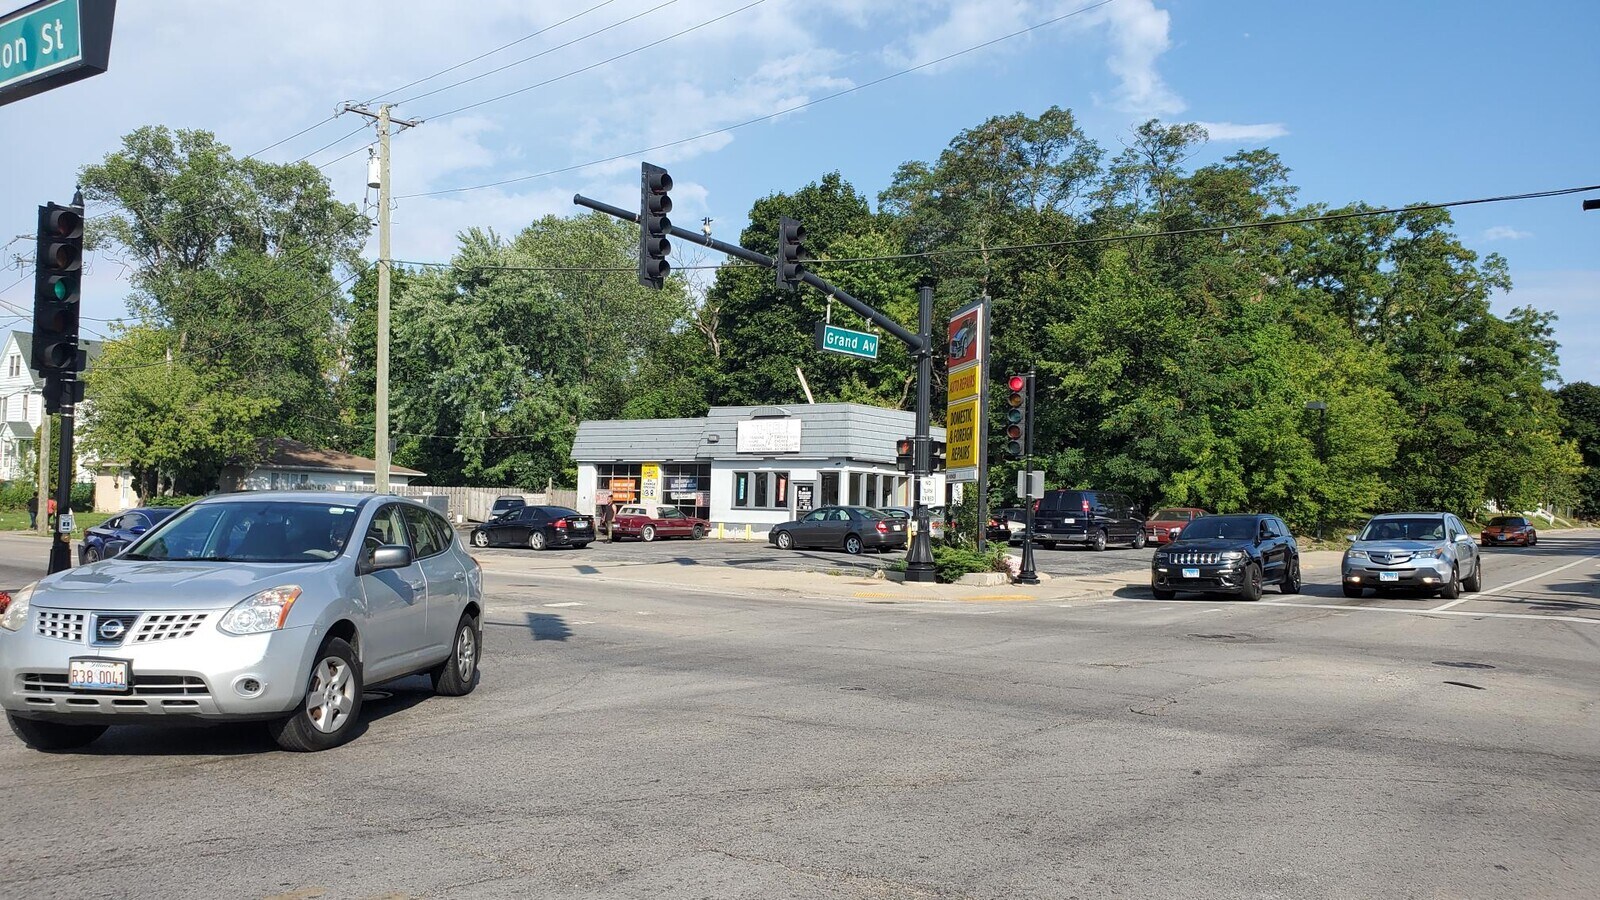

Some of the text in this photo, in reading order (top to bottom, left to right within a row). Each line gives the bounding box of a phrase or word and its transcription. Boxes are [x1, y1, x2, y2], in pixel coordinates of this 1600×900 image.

[42, 18, 63, 54] St
[827, 332, 875, 352] Grand Av
[950, 408, 973, 426] DOMESTIC
[949, 427, 973, 444] & FOREIGN
[951, 445, 971, 461] REPAIRS
[72, 669, 125, 686] R38 0041
